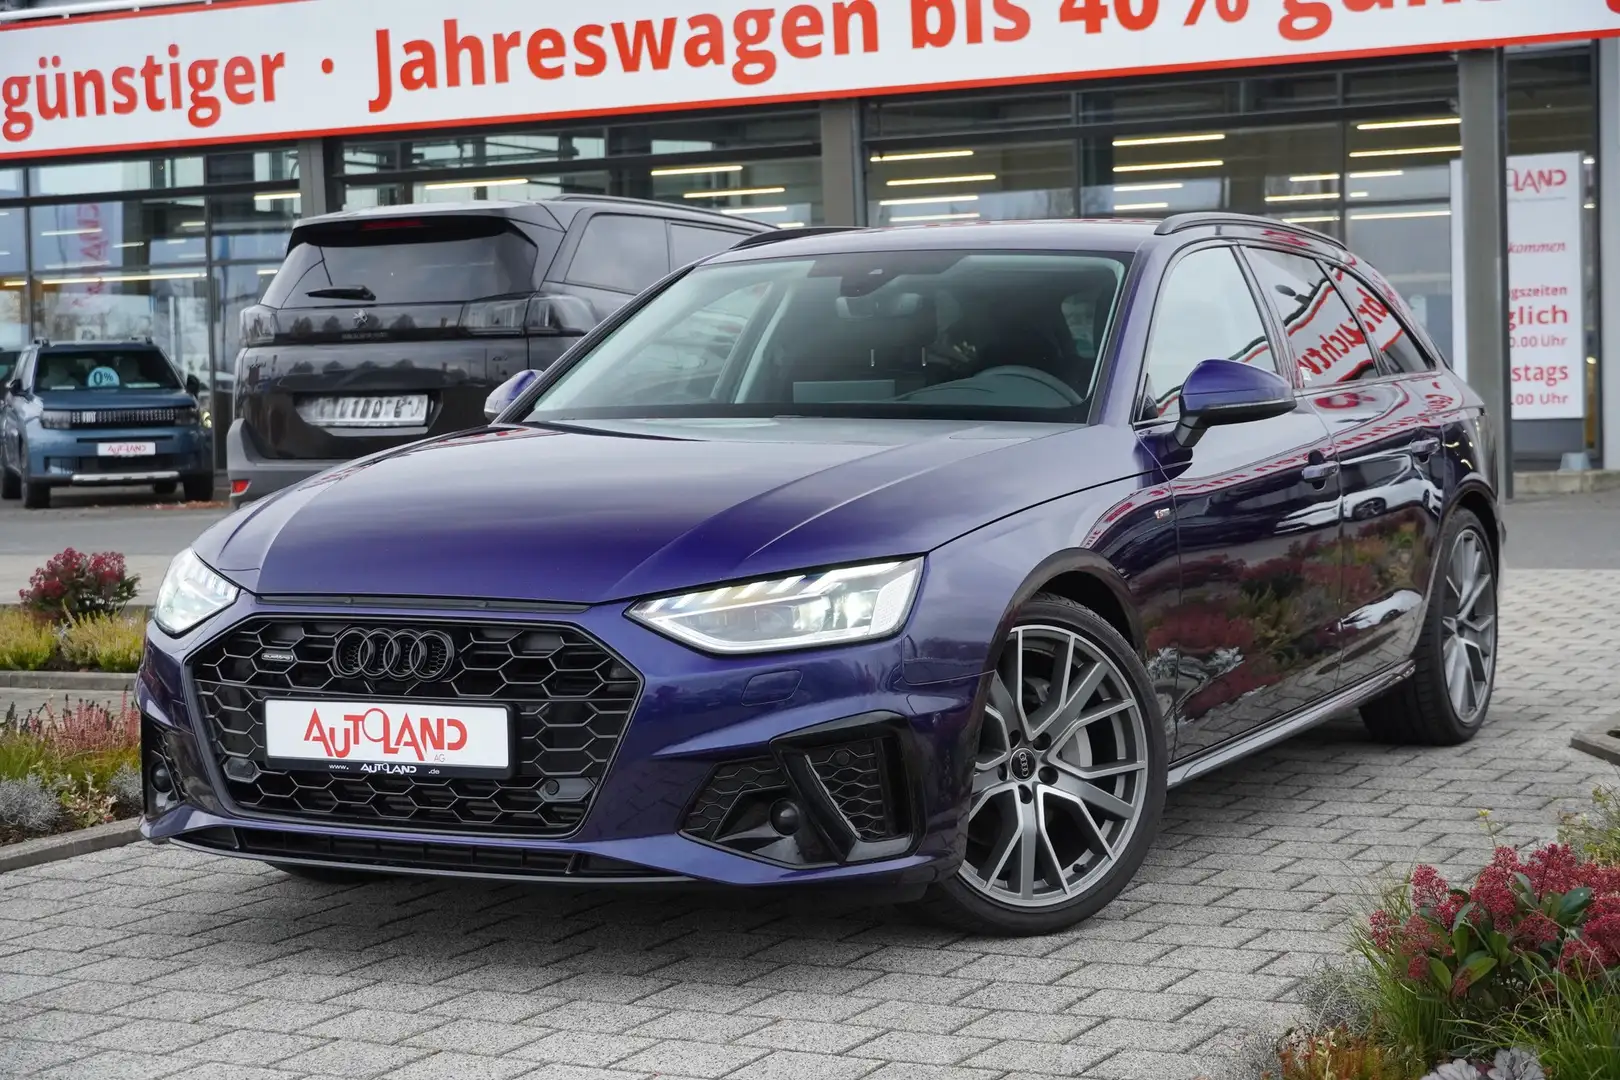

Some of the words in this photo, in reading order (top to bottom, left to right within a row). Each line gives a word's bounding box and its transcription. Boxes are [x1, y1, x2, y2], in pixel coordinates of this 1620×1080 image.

[2, 44, 285, 142] günstiger
[367, 0, 879, 112] Jahreswagen
[910, 0, 1031, 49] bis
[1540, 334, 1568, 347] Uhr
[1511, 364, 1569, 387] stags
[1539, 392, 1569, 405] Uhr
[303, 708, 468, 762] AUTOLAND
[434, 753, 446, 763] AG
[328, 763, 350, 771] www.
[360, 762, 418, 775] AUTOLAND
